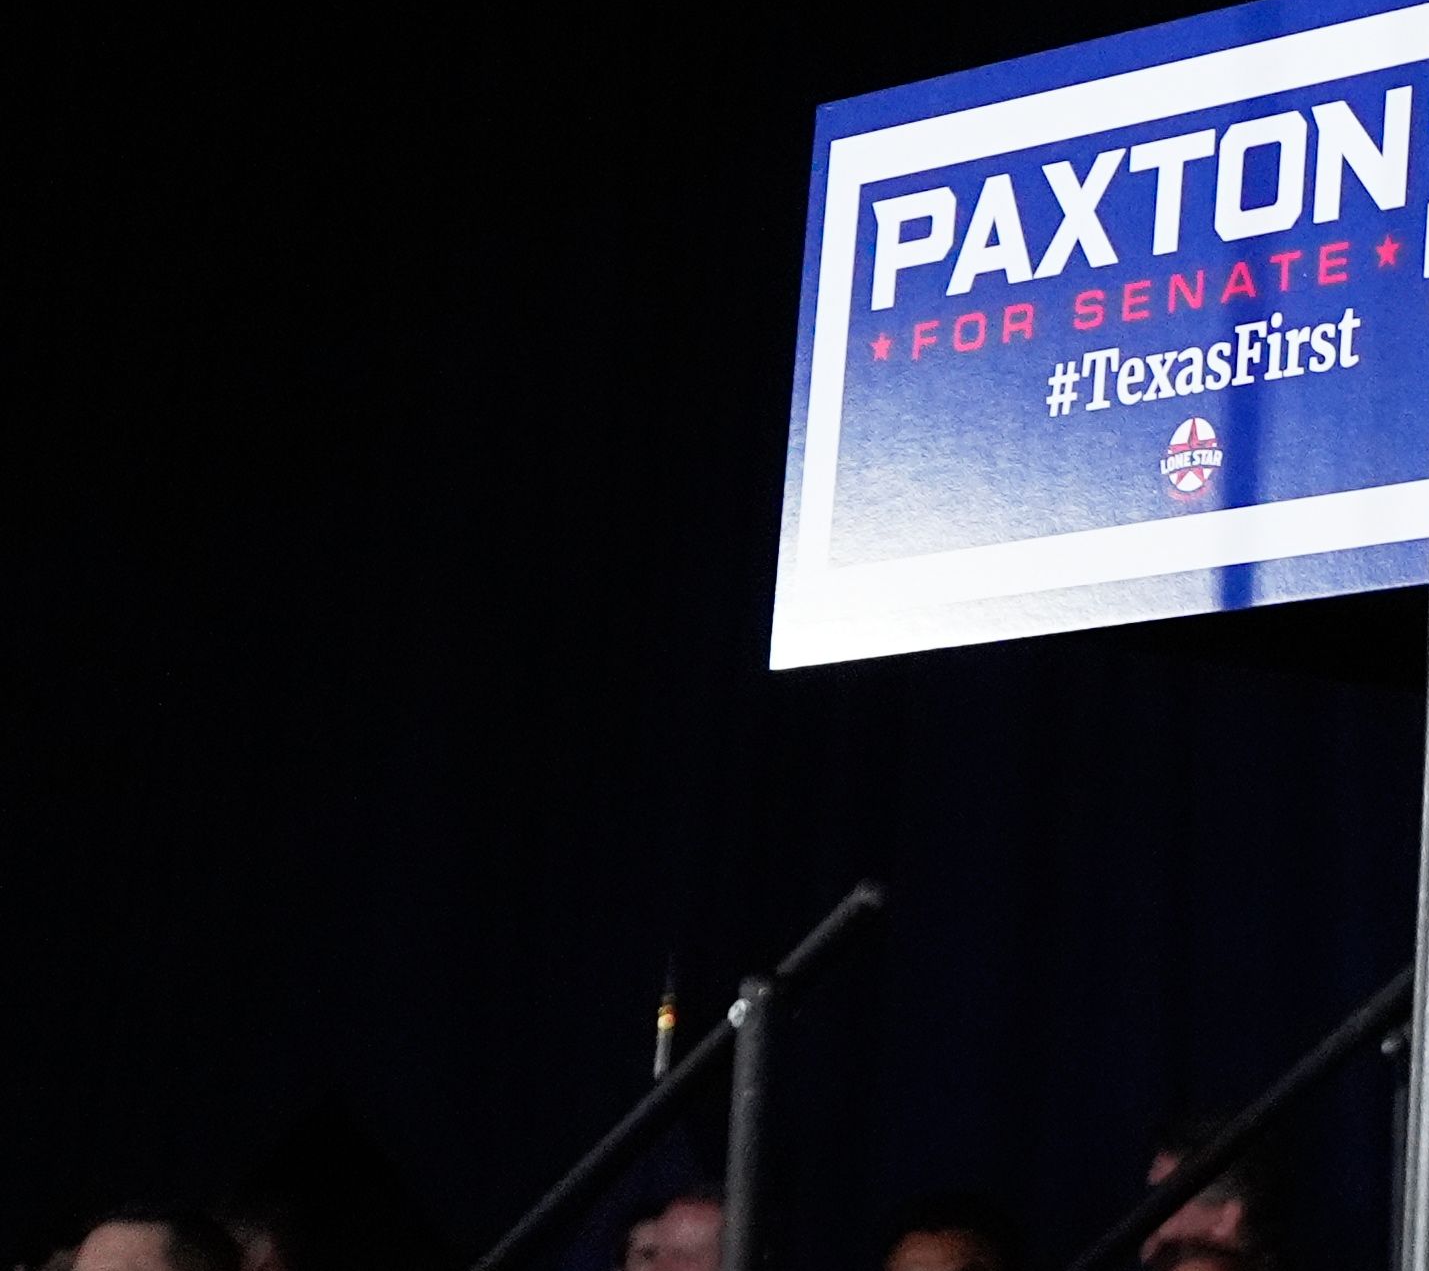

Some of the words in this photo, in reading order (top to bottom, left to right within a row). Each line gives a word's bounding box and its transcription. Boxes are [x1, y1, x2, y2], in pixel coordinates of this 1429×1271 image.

[871, 85, 1413, 311] PAXTON
[911, 303, 1036, 361] FOR
[1073, 241, 1351, 331] SENATE
[1046, 307, 1361, 417] #TexasFirst
[1160, 450, 1192, 474] LONE
[1192, 449, 1224, 468] STAR
